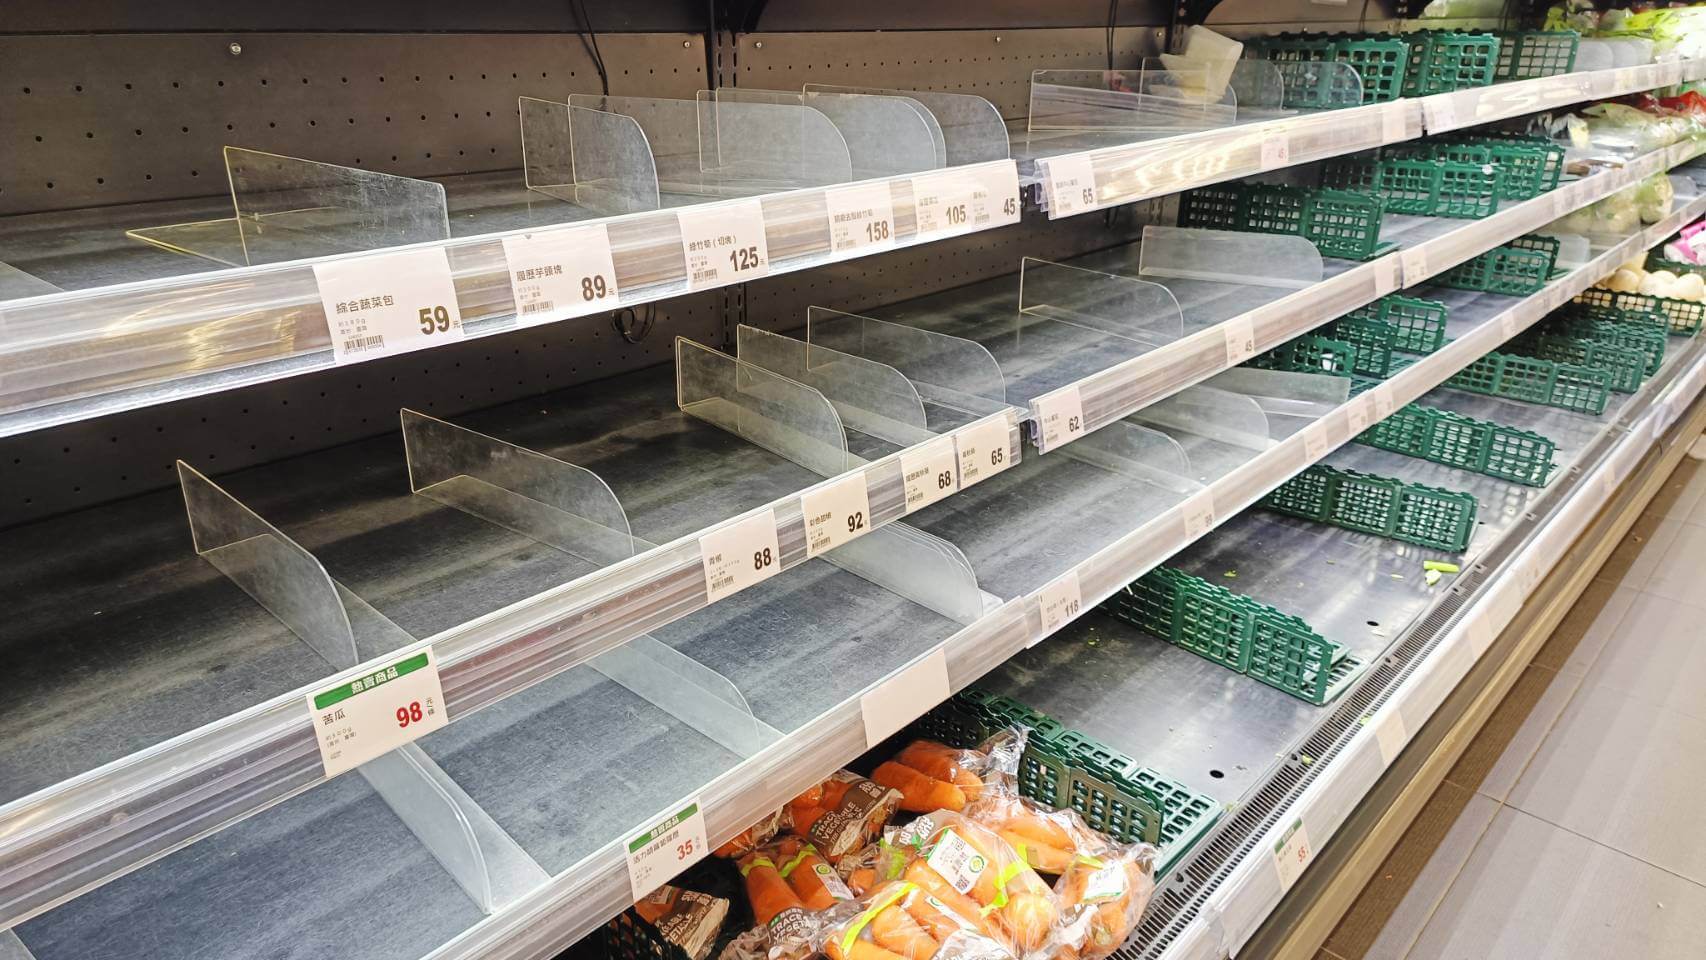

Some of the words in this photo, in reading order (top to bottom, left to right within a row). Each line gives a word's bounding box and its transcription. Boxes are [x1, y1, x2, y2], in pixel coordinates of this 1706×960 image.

[1003, 197, 1016, 216] 45
[1082, 187, 1093, 205] 65
[946, 204, 967, 225] 105
[866, 220, 889, 242] 158
[730, 246, 759, 272] 125
[582, 275, 606, 301] 89
[336, 295, 394, 315] 綜合蔬菜包
[419, 305, 450, 335] 59
[1069, 415, 1080, 432] 62
[991, 447, 1003, 466] 65
[938, 470, 951, 489] 68
[847, 511, 864, 533] 92
[754, 547, 772, 570] 88
[1064, 599, 1079, 617] 118
[322, 707, 346, 726] 苦瓜
[396, 701, 423, 728] 98
[676, 839, 693, 861] 35
